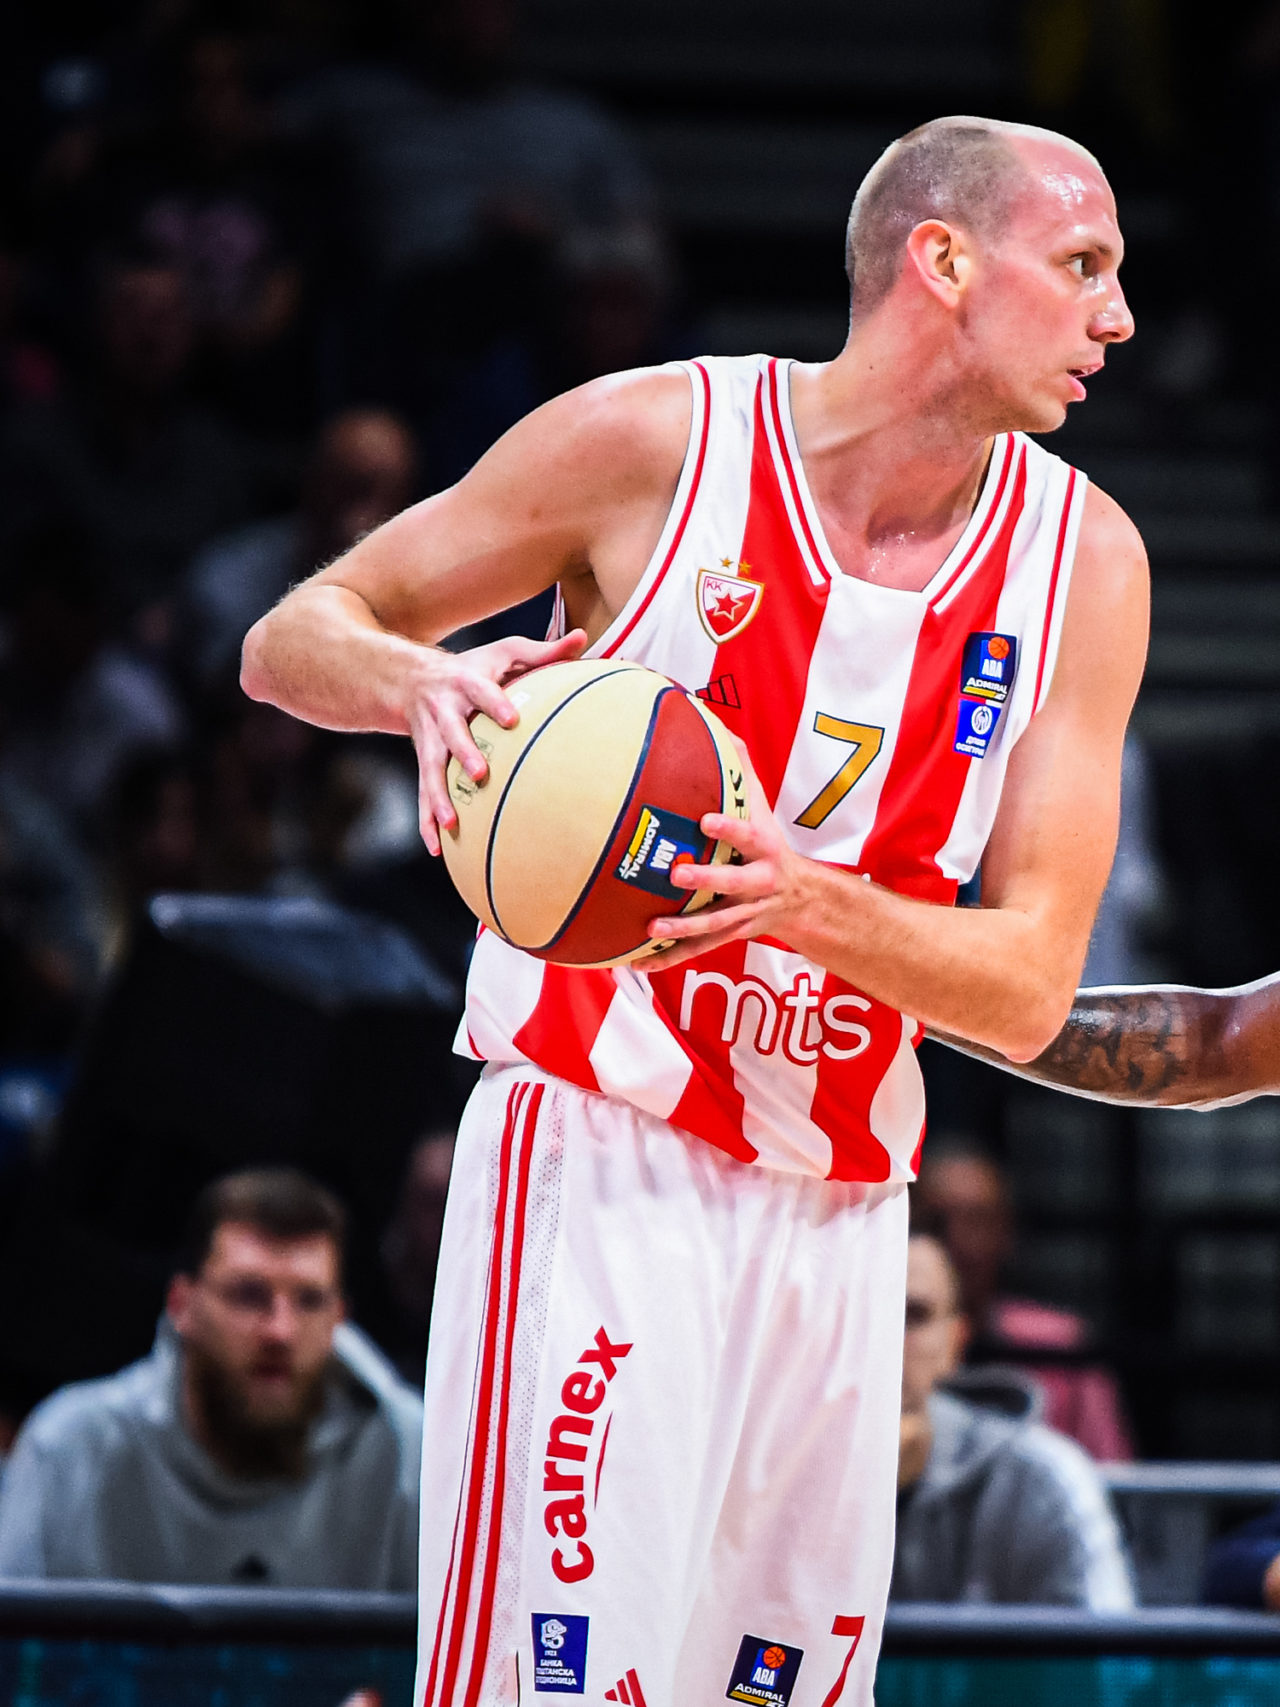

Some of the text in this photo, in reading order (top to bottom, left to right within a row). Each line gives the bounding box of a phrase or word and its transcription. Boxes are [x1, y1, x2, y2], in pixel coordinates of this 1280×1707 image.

[706, 580, 723, 592] KK
[966, 677, 1008, 694] ADMIRAL
[793, 711, 885, 830] 7
[628, 814, 660, 878] ADMIRAL
[650, 838, 677, 870] ABA
[679, 969, 872, 1061] mts
[542, 1326, 634, 1583] carnex
[752, 1667, 775, 1686] ABA
[821, 1614, 865, 1707] 7
[734, 1683, 785, 1704] ADMIRAL
